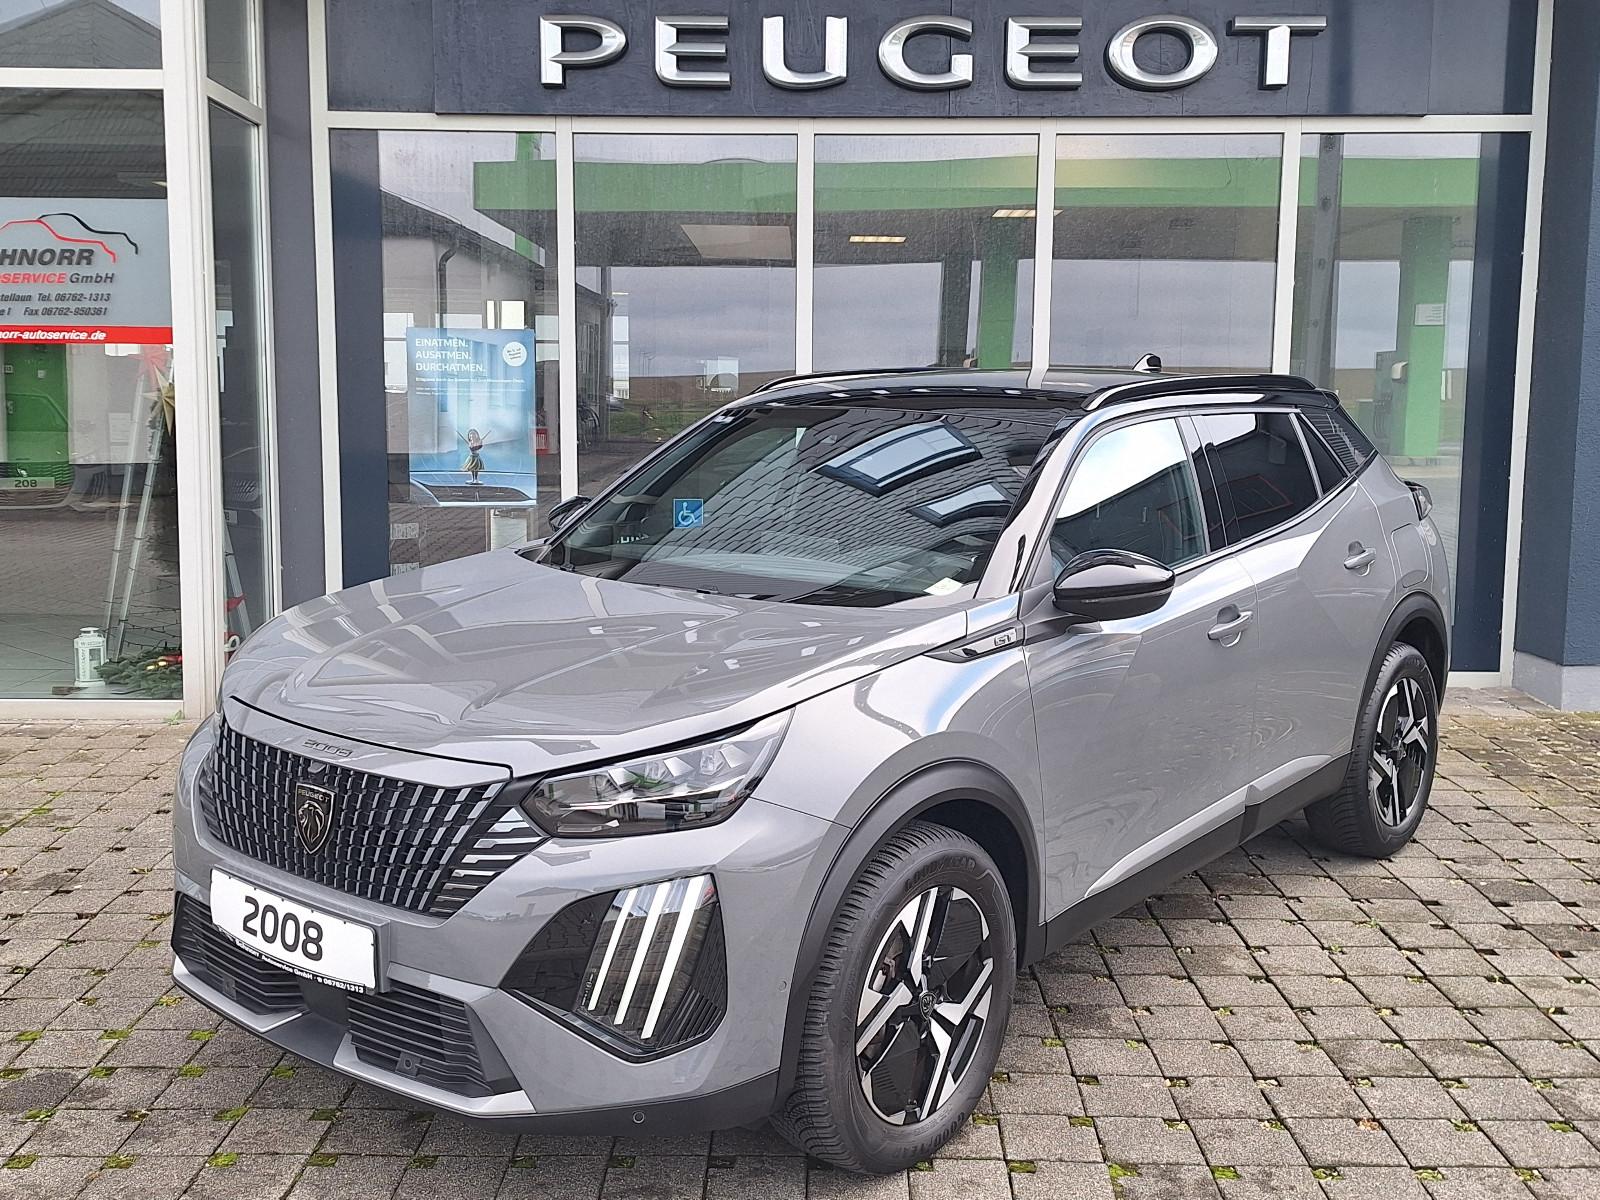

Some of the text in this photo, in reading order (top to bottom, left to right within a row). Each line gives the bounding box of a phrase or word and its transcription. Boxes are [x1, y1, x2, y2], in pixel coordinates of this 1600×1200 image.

[539, 14, 1327, 89] PEUGEOT
[0, 273, 115, 283] SERVICE GmbH
[54, 292, 111, 302] 06762-1313
[23, 307, 40, 316] Fax
[415, 338, 469, 348] EINATMEN.
[415, 350, 472, 360] AUSATMEN.
[415, 362, 487, 372] DURCHATMEN.
[14, 479, 38, 488] 208
[302, 739, 354, 758] 2008
[298, 788, 330, 803] PEUGEOT
[243, 896, 323, 961] 2008
